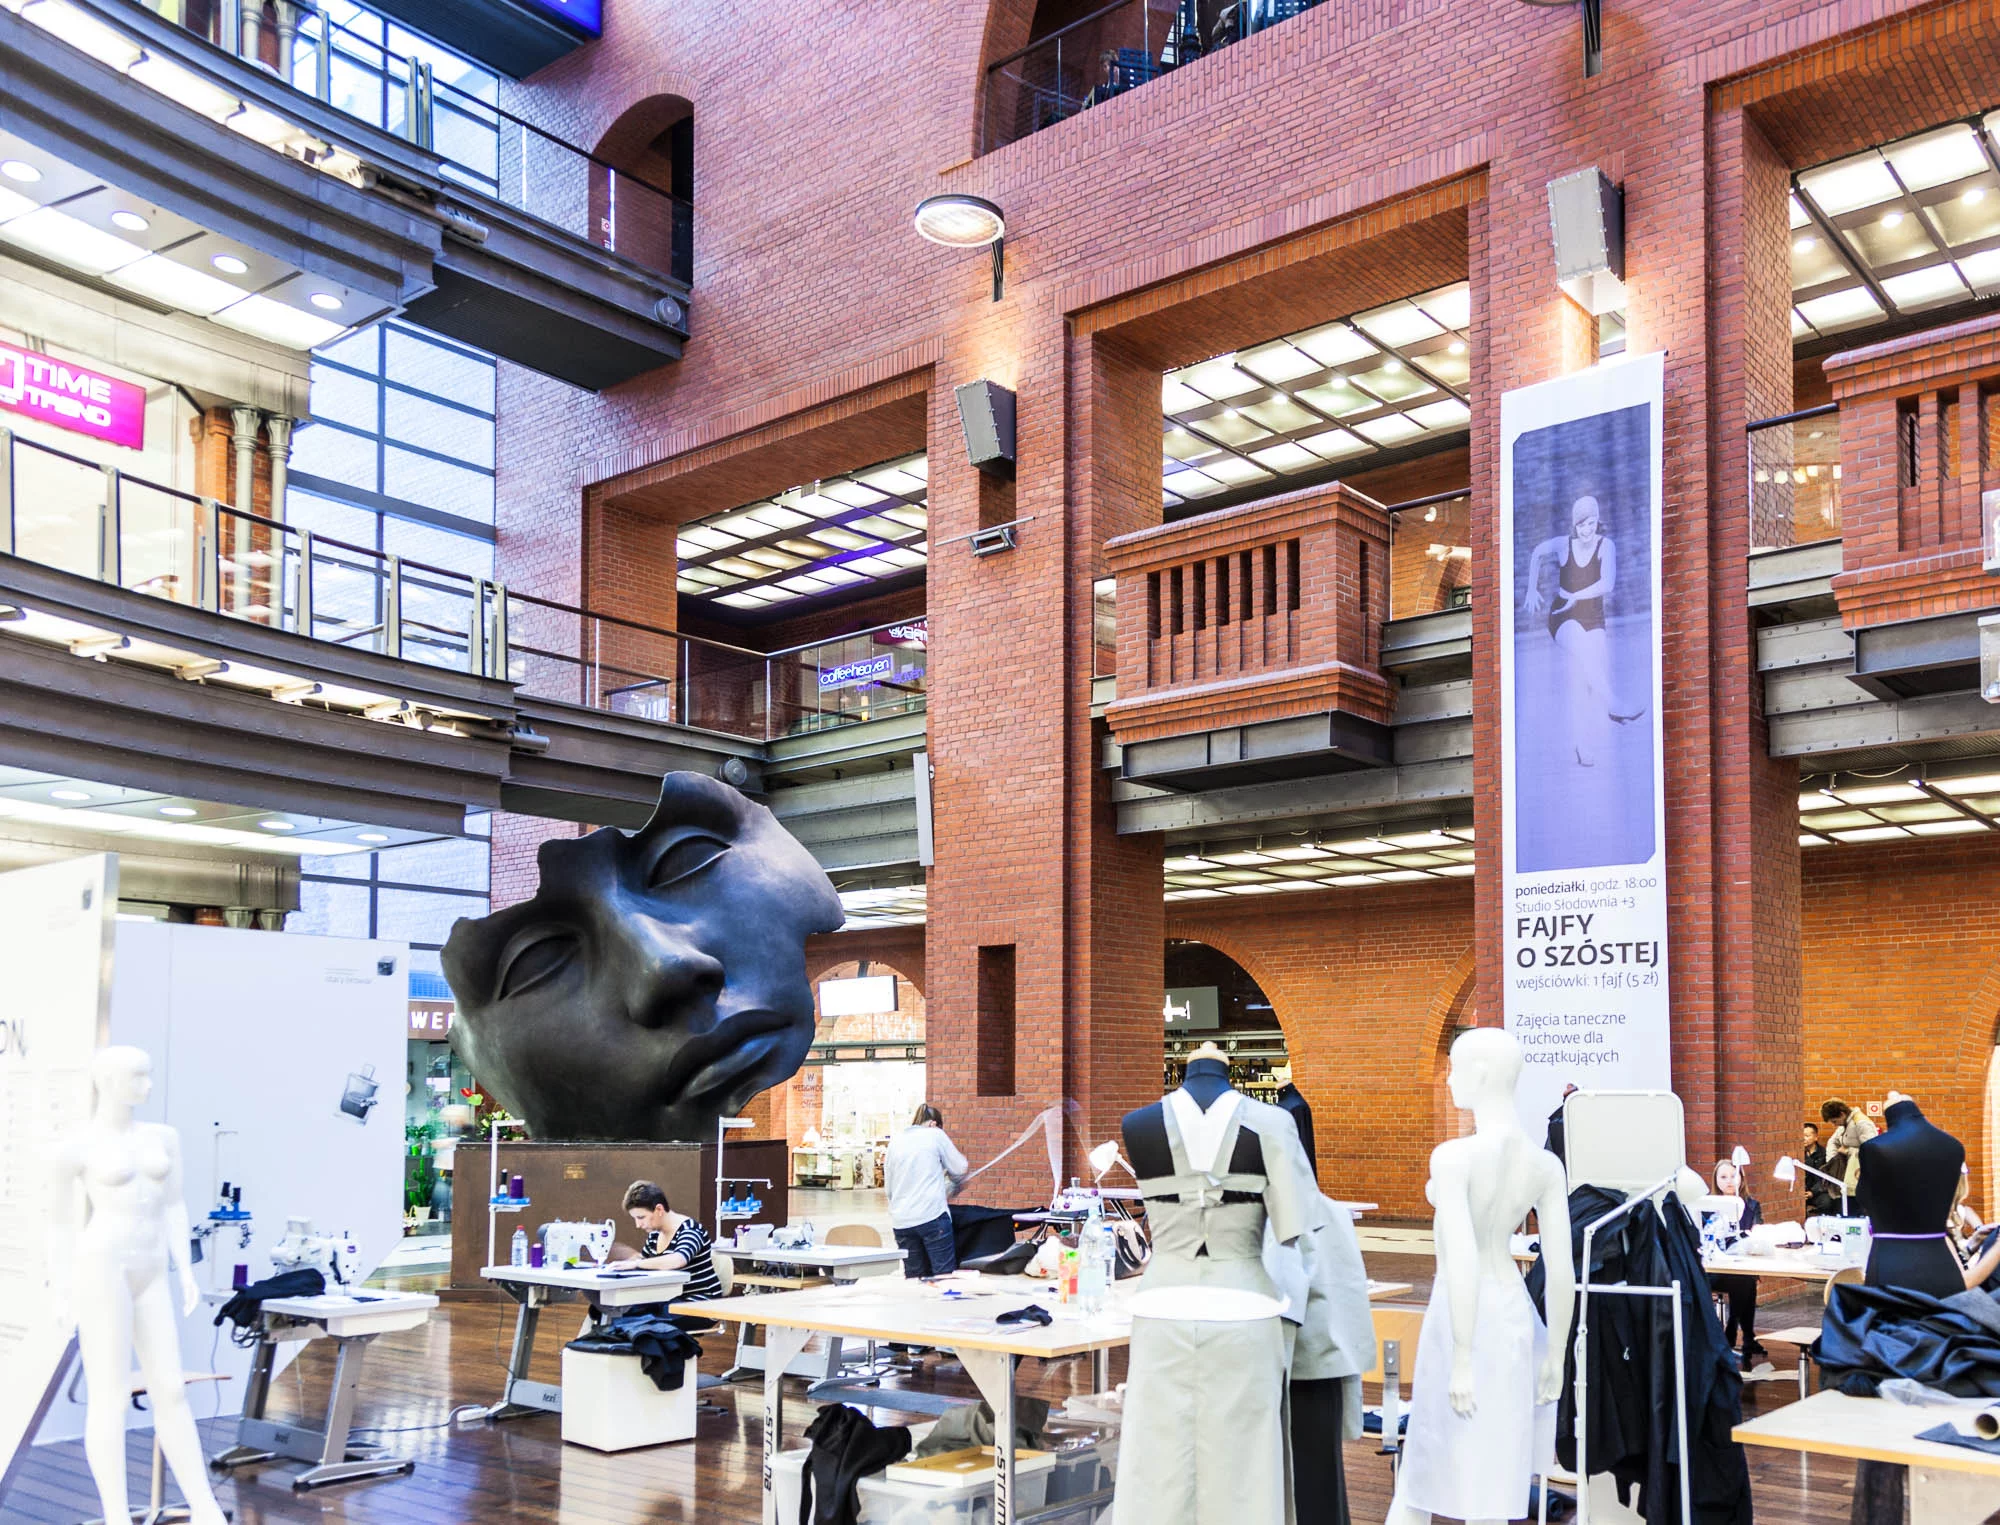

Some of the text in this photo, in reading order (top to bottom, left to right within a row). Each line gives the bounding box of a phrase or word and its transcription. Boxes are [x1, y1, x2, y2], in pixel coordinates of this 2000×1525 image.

[25, 356, 111, 404] TIME
[24, 384, 111, 427] TREND
[820, 659, 889, 685] coffeeheaven
[1625, 877, 1657, 889] 18:00
[1515, 896, 1636, 913] Studio Słodownia +3
[1517, 913, 1594, 942] FAJFY
[1516, 939, 1659, 968] O SZÓSTEJ
[1516, 971, 1659, 991] wejściówki: 1 fajf (5 zł)
[1516, 1013, 1626, 1030] Zajęcia taneczne
[1523, 1031, 1581, 1045] ruchowe
[1584, 1031, 1604, 1044] dla
[1524, 1050, 1620, 1066] oczątkujących
